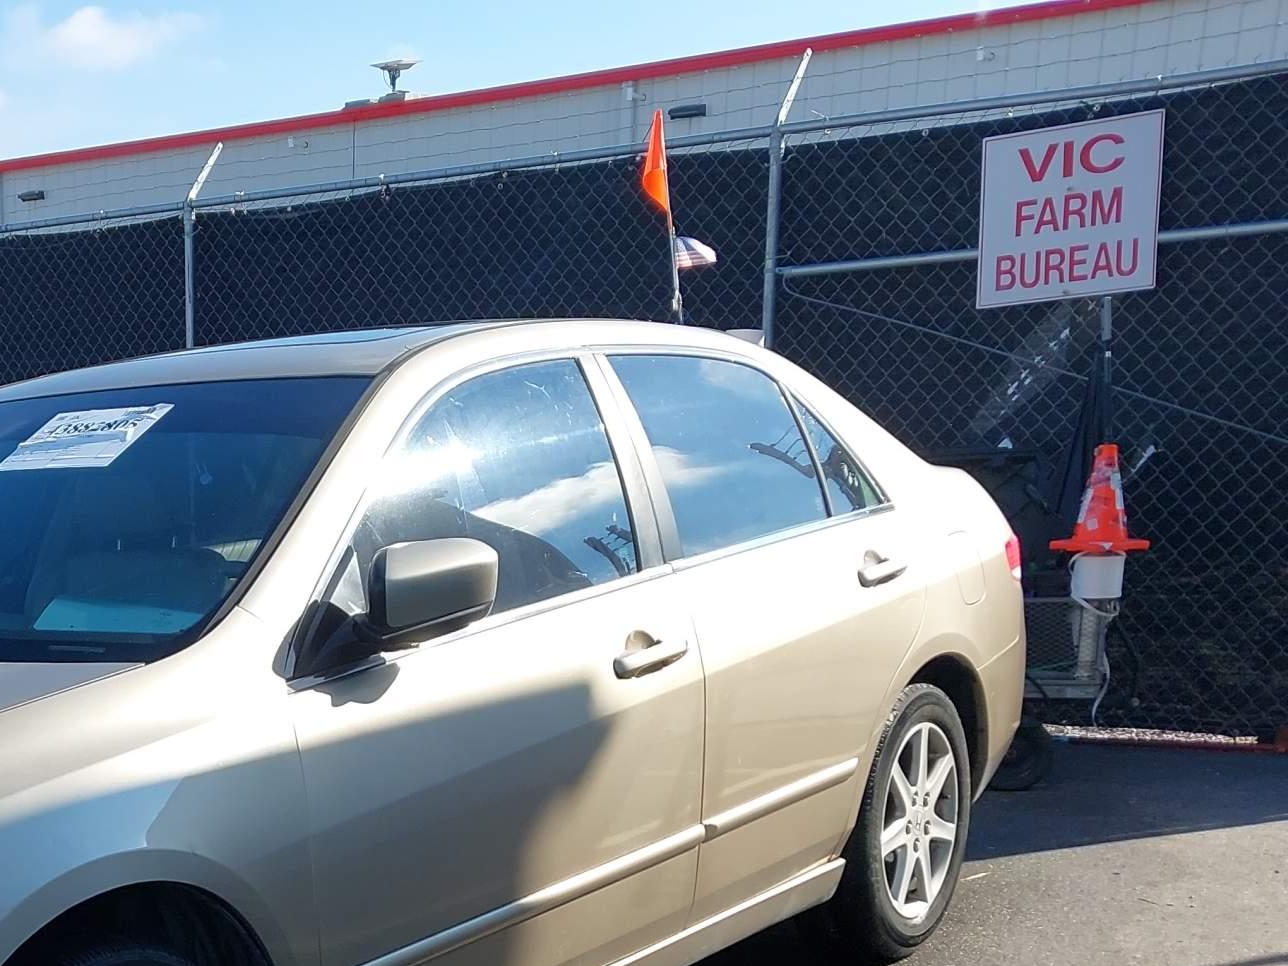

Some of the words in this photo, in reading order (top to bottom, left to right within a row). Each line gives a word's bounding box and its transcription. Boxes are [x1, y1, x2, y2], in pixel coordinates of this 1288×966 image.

[1018, 133, 1126, 183] VIC
[1015, 186, 1123, 238] FARM
[994, 238, 1139, 292] BUREAU
